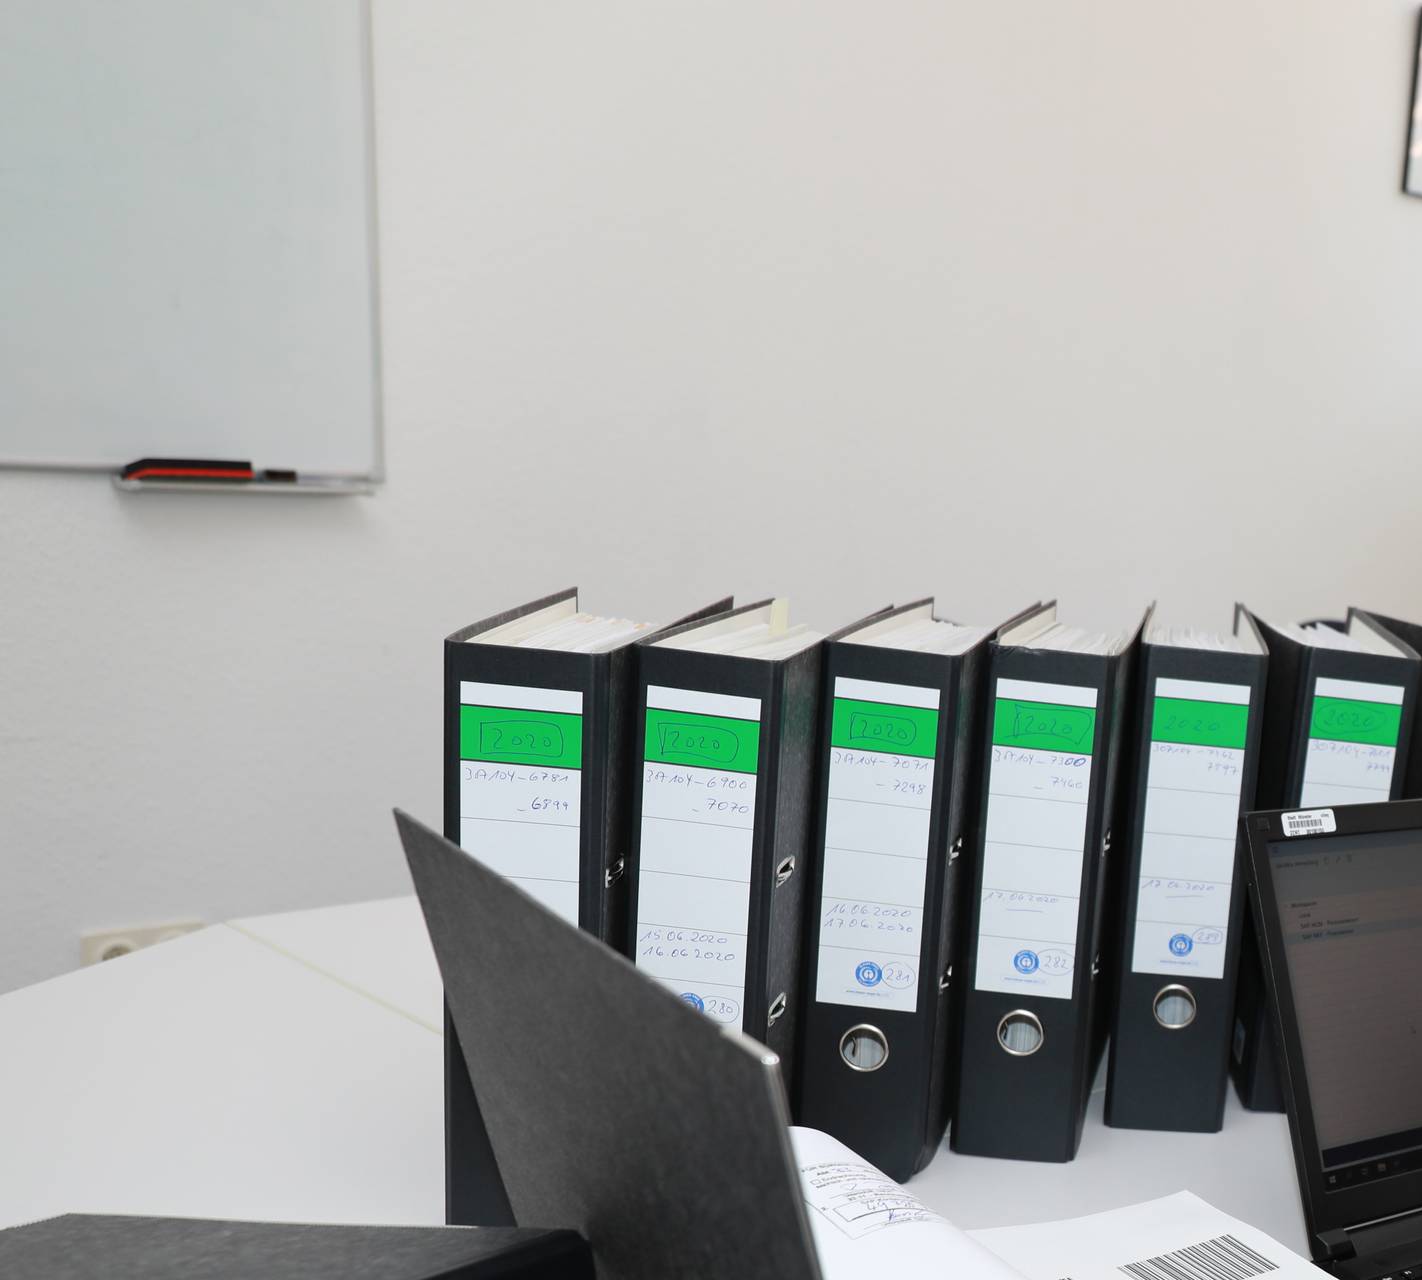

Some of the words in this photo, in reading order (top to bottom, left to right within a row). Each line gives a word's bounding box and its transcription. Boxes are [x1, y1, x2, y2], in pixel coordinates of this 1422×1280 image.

[861, 719, 909, 740] 2020
[1025, 715, 1073, 734] 2020
[1163, 714, 1220, 733] 2020
[492, 727, 552, 750] 2020
[671, 730, 720, 751] 2020
[708, 999, 734, 1015] 280
